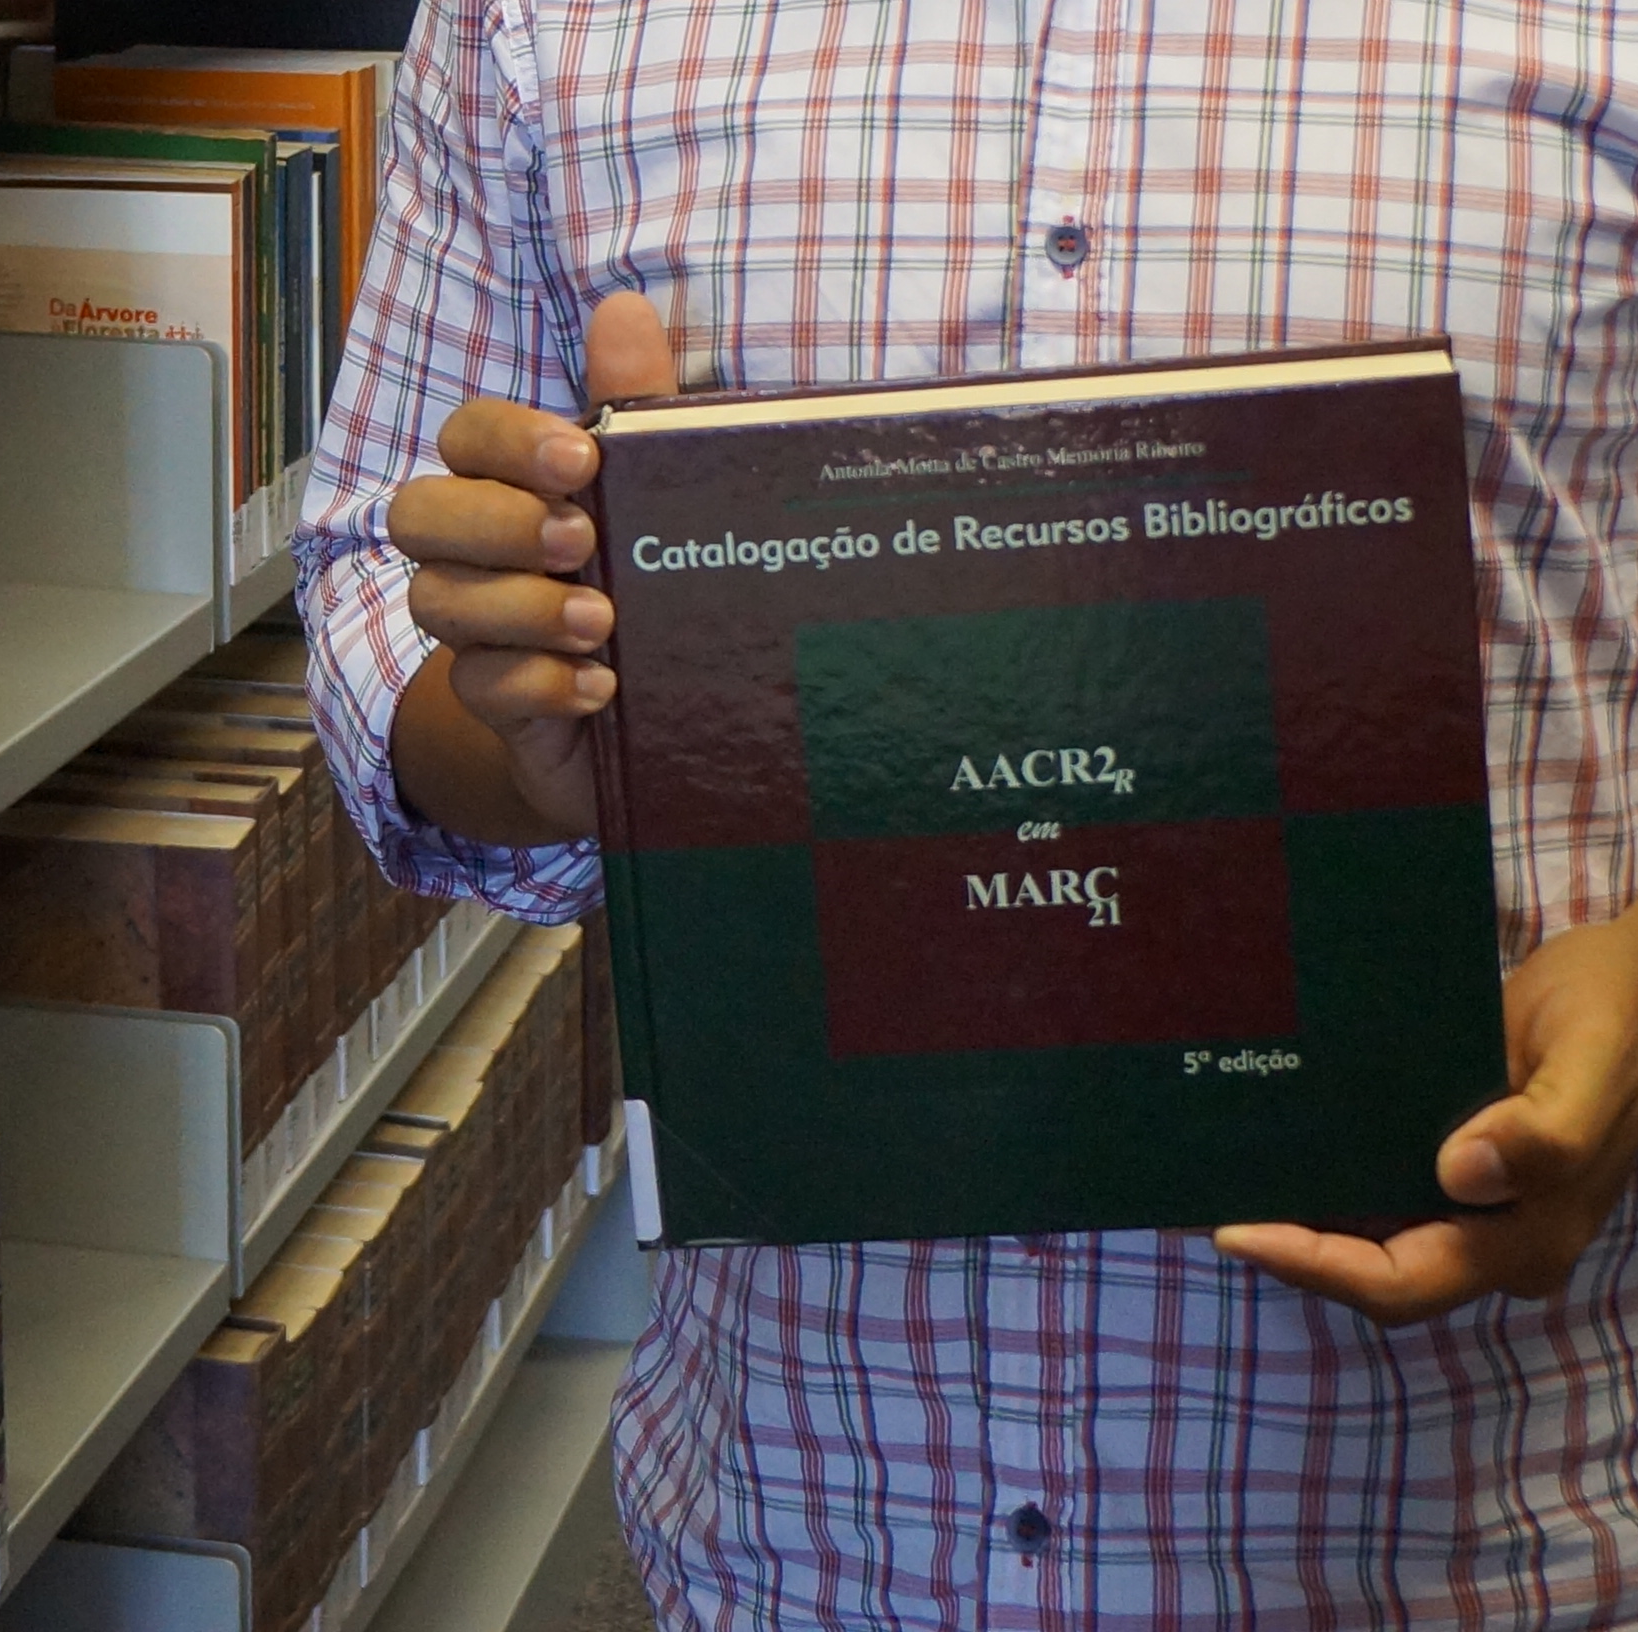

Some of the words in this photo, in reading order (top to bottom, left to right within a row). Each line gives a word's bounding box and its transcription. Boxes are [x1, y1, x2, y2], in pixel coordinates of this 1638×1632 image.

[79, 298, 158, 325] Árvore
[954, 453, 978, 473] de
[981, 448, 1041, 472] Castro
[1135, 440, 1207, 460] Ribeiro
[630, 524, 881, 573] Catalogação
[891, 518, 941, 556] de
[952, 512, 1131, 550] Recursos
[1142, 490, 1415, 540] Bibliográficos
[1017, 815, 1062, 843] em
[964, 865, 1121, 912] MARC
[1087, 901, 1122, 928] 21
[1218, 1046, 1301, 1076] edição
